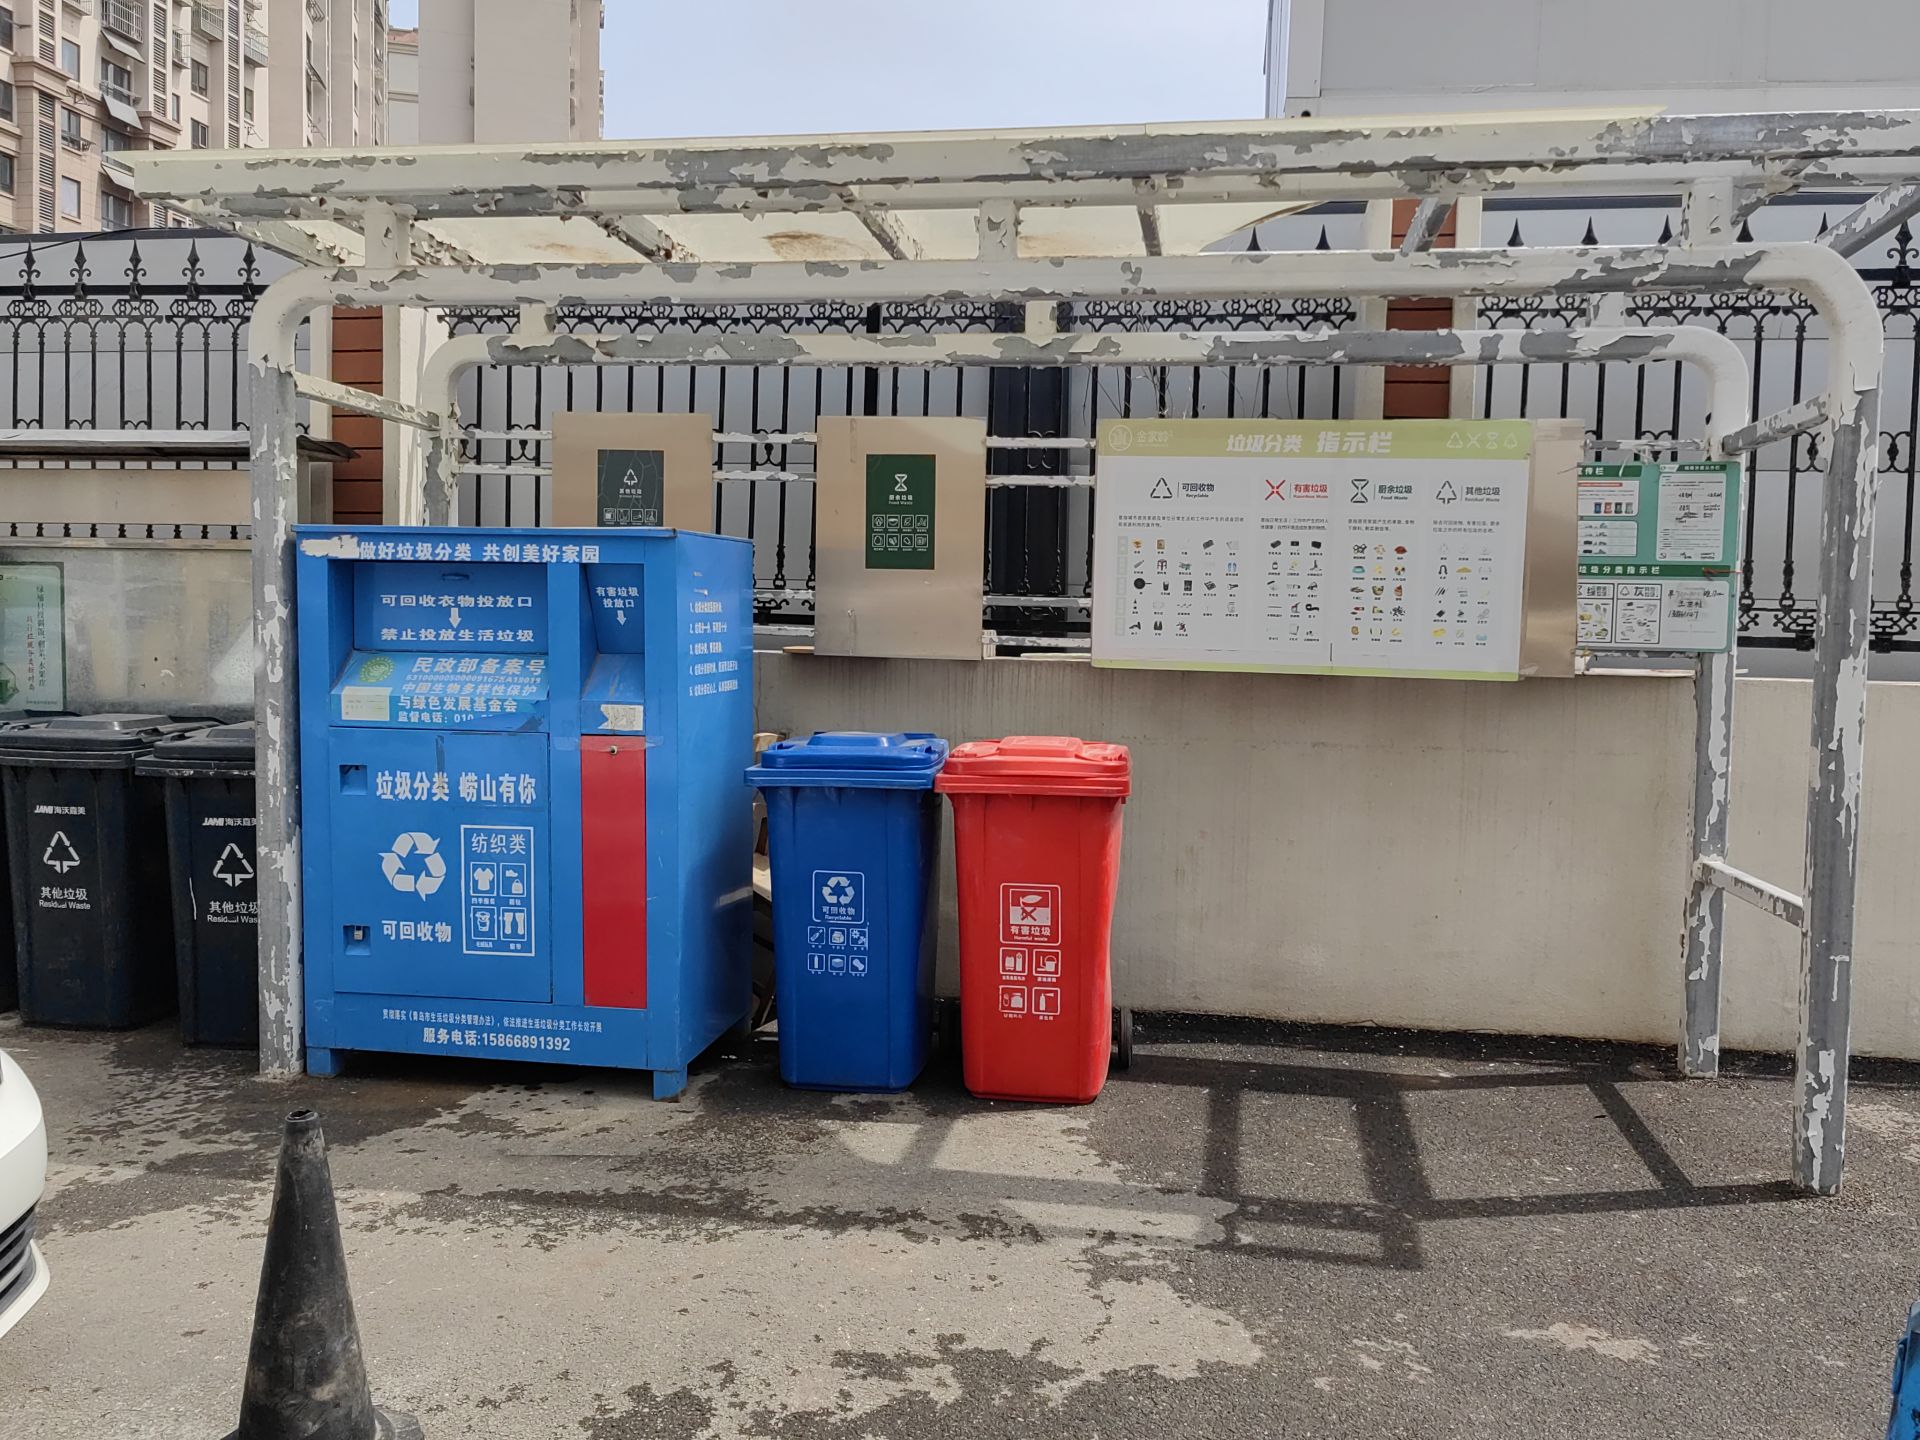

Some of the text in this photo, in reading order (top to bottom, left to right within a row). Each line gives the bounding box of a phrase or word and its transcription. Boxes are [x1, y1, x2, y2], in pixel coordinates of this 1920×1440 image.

[1226, 431, 1392, 453] 垃圾分类 指示栏
[1181, 482, 1214, 492] 可回收物
[1294, 484, 1328, 493] 有害垃圾
[1378, 484, 1413, 494] 厨余垃圾
[1465, 486, 1500, 496] 其他垃圾
[359, 542, 600, 564] 做好垃圾分类 共创美好家园
[1578, 566, 1660, 575] 垃圾分类指示栏
[596, 586, 640, 597] 有害垃圾
[380, 594, 532, 608] 可回收衣物投放口
[603, 598, 634, 608] 投放口
[381, 628, 534, 642] 禁止投放生活垃圾
[412, 657, 546, 676] 民政部备案号
[402, 682, 537, 696] 中国生物多样性保护
[398, 695, 518, 712] 与绿色发展基金会
[376, 771, 536, 804] 垃圾分类 崂山有你
[472, 833, 526, 854] 纺织类
[41, 886, 88, 900] 其他垃圾
[68, 901, 91, 909] Waste
[209, 900, 258, 914] 其他垃圾
[822, 906, 855, 915] 可回收物
[381, 920, 452, 943] 可回收物
[1010, 926, 1050, 936] 有害垃圾
